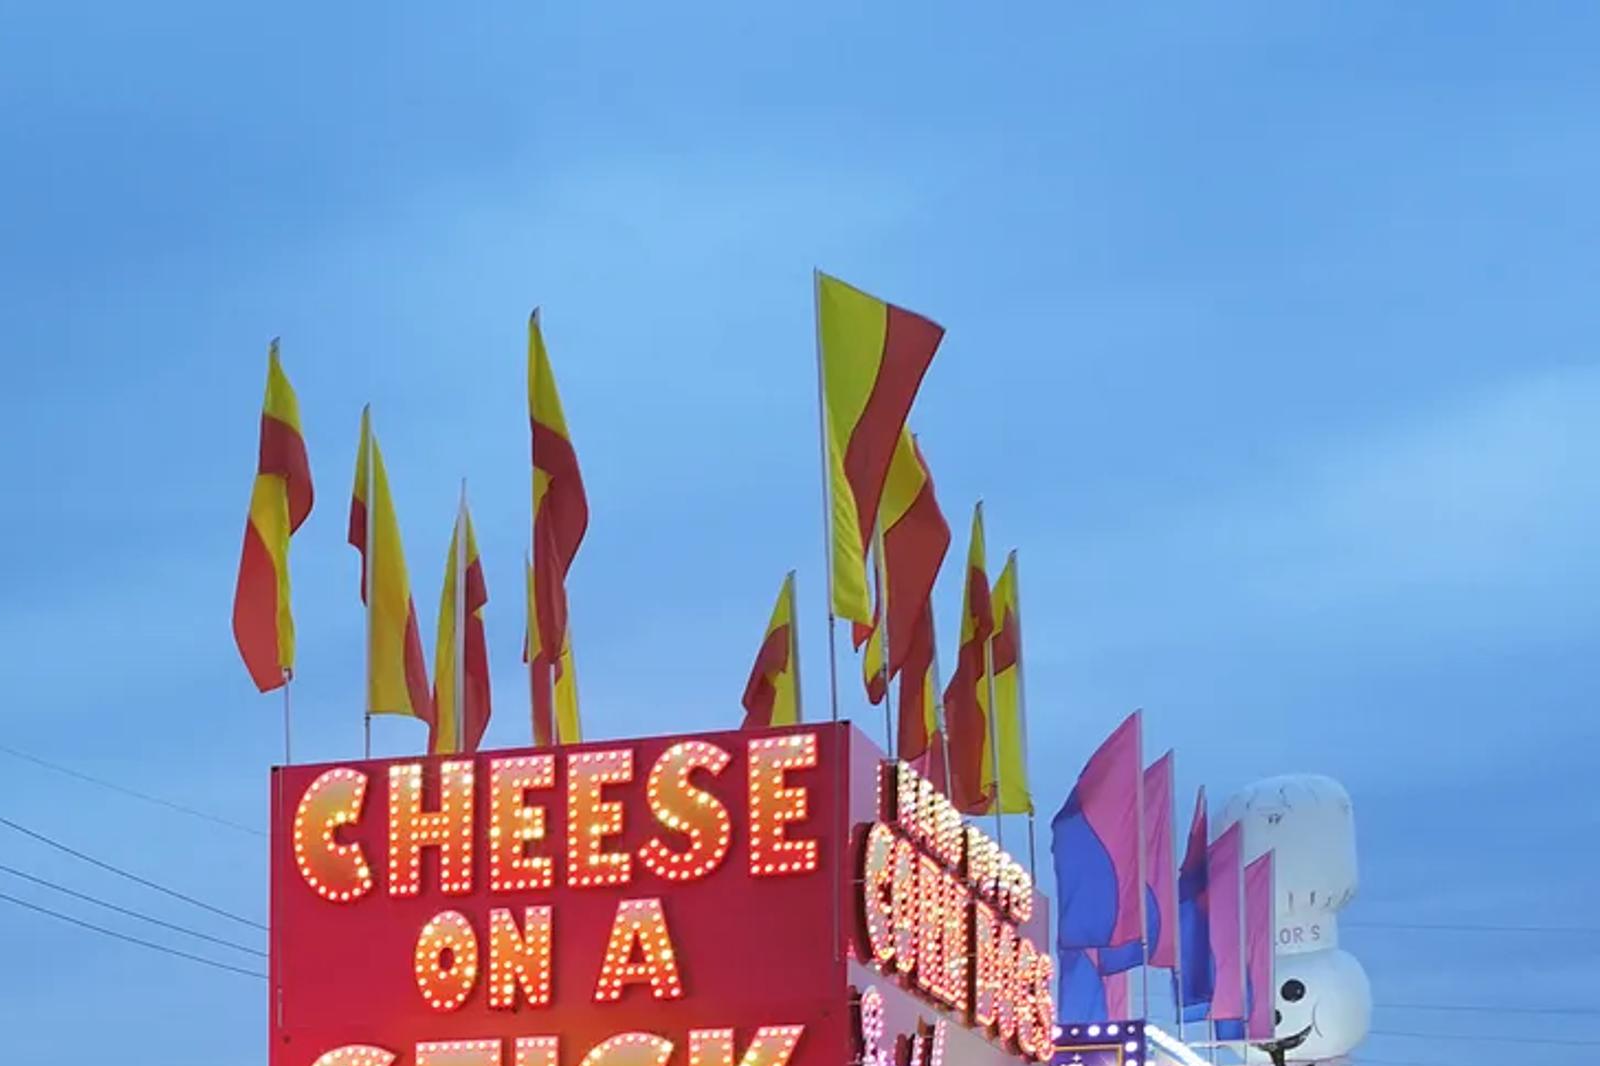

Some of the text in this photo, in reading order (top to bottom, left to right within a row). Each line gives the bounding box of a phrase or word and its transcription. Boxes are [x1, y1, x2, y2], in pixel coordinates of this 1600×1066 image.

[293, 732, 818, 902] CHEESE
[414, 897, 684, 1012] ON A
